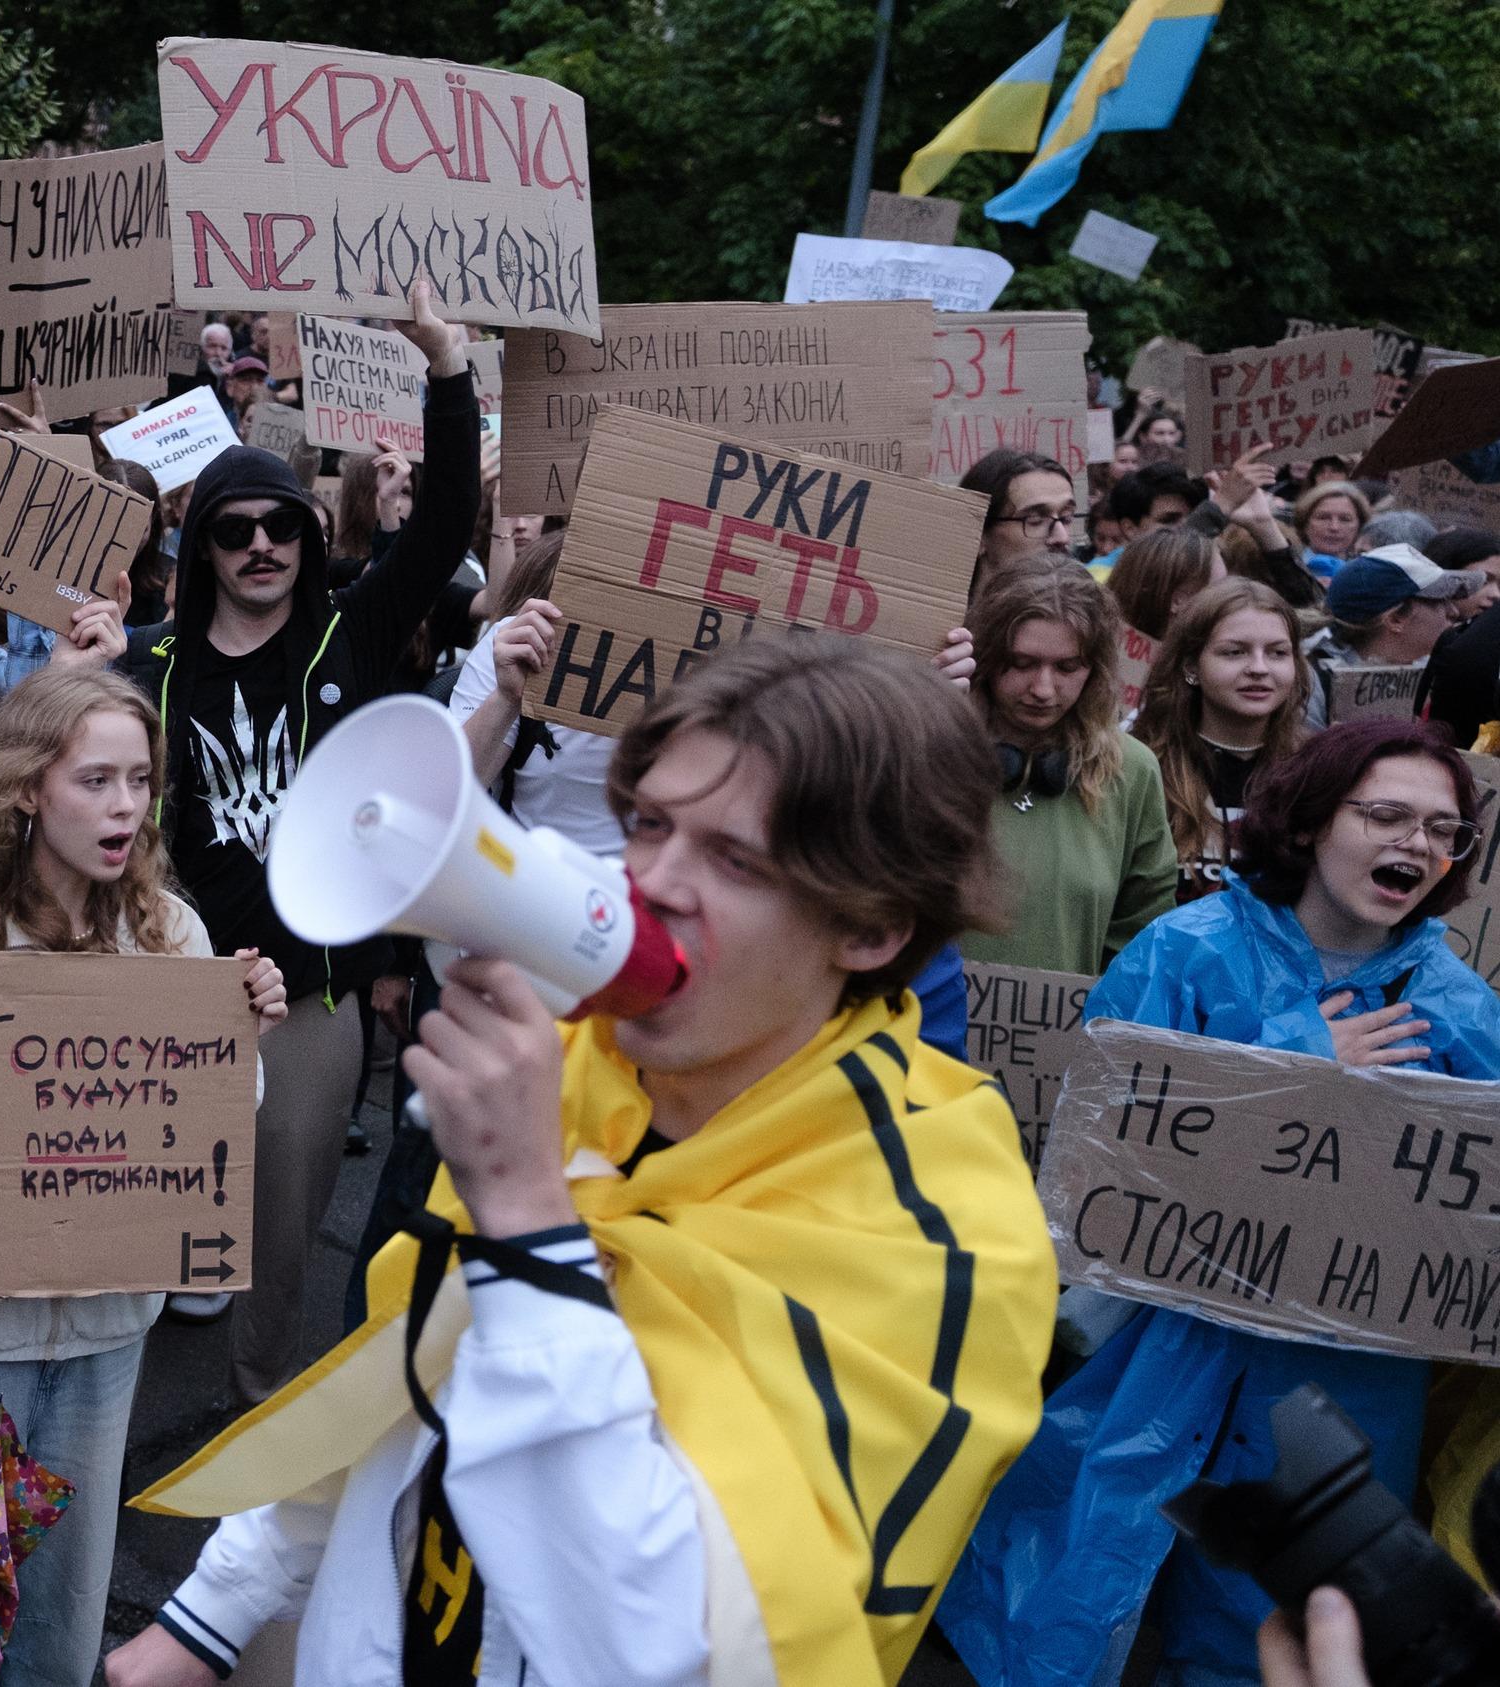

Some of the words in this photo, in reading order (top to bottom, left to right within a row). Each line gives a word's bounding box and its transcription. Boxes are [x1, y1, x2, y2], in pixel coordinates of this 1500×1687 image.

[332, 197, 590, 325] МОСКОВІЯ
[300, 316, 366, 359] НАХУЯ
[369, 337, 408, 365] МЕНІ
[545, 331, 566, 374] В
[590, 323, 699, 373] УКРАЇНІ
[719, 319, 829, 368] ПОВИННІ
[310, 380, 387, 414] ПРАЦЮЄ
[1210, 351, 1326, 397] РУКИ
[131, 405, 197, 441] ВИМАГАЮ
[741, 379, 850, 426] ЗАКОНИ,
[1213, 391, 1297, 431] ГЕТЬ
[155, 427, 190, 448] УРЯД
[927, 406, 1088, 477] АЛЕЖНІСТЬ
[546, 462, 565, 502] А
[706, 443, 872, 548] РУКИ
[638, 498, 879, 636] ГЕТЬ
[35, 1077, 179, 1112] БУДУТЬ
[1261, 1121, 1341, 1183] ЗА
[1392, 1123, 1500, 1215] 45
[1074, 1184, 1292, 1304] СТОЯЛИ
[1316, 1236, 1381, 1320] НА
